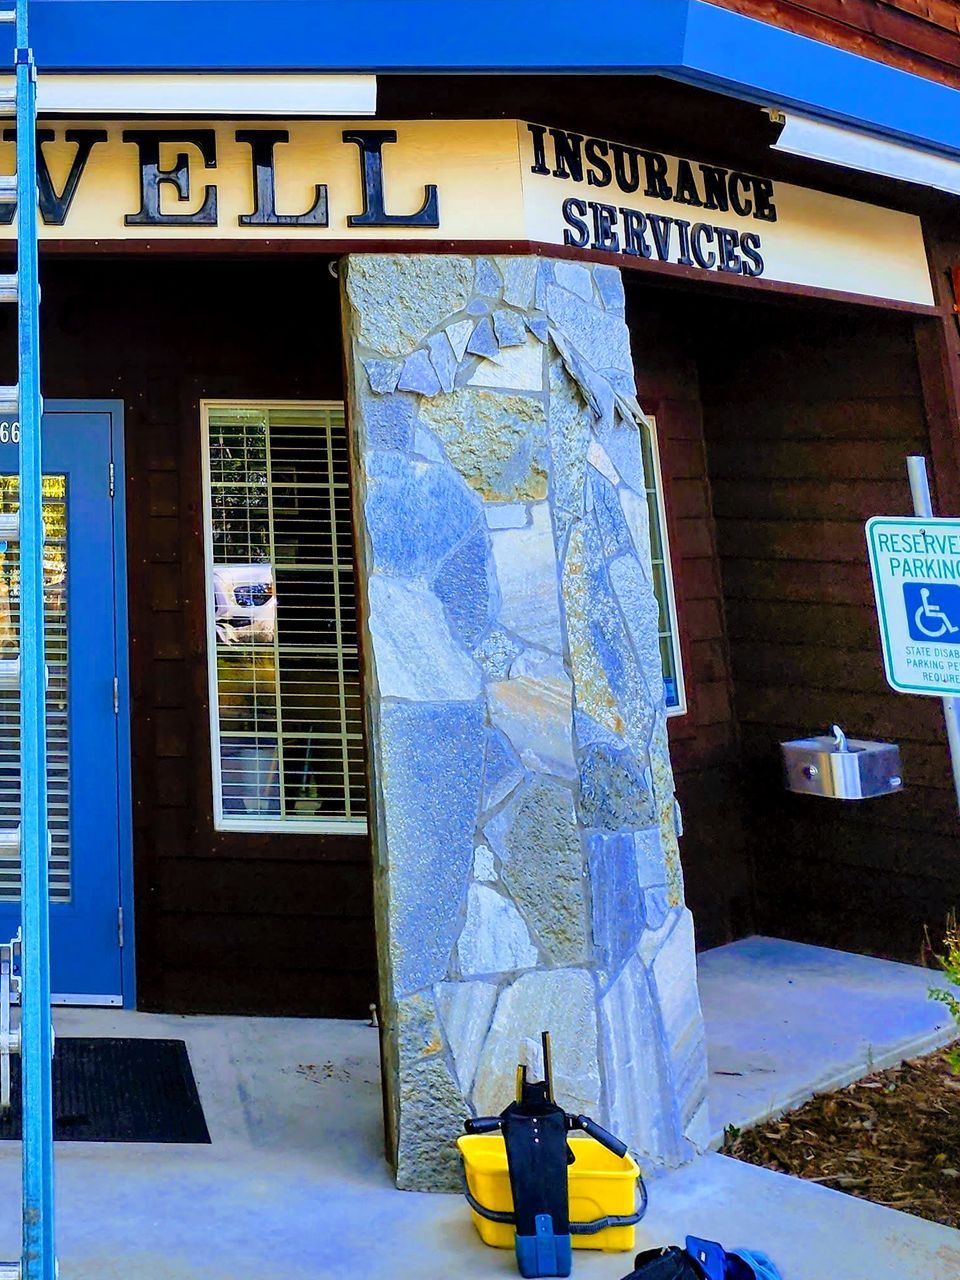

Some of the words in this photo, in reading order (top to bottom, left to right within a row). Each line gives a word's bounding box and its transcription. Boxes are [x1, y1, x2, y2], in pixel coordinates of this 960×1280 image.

[527, 123, 777, 222] INSURANCE
[562, 197, 766, 277] SERVICES
[878, 533, 960, 555] RESERVE
[905, 646, 931, 657] STATE
[906, 658, 944, 670] PARKING
